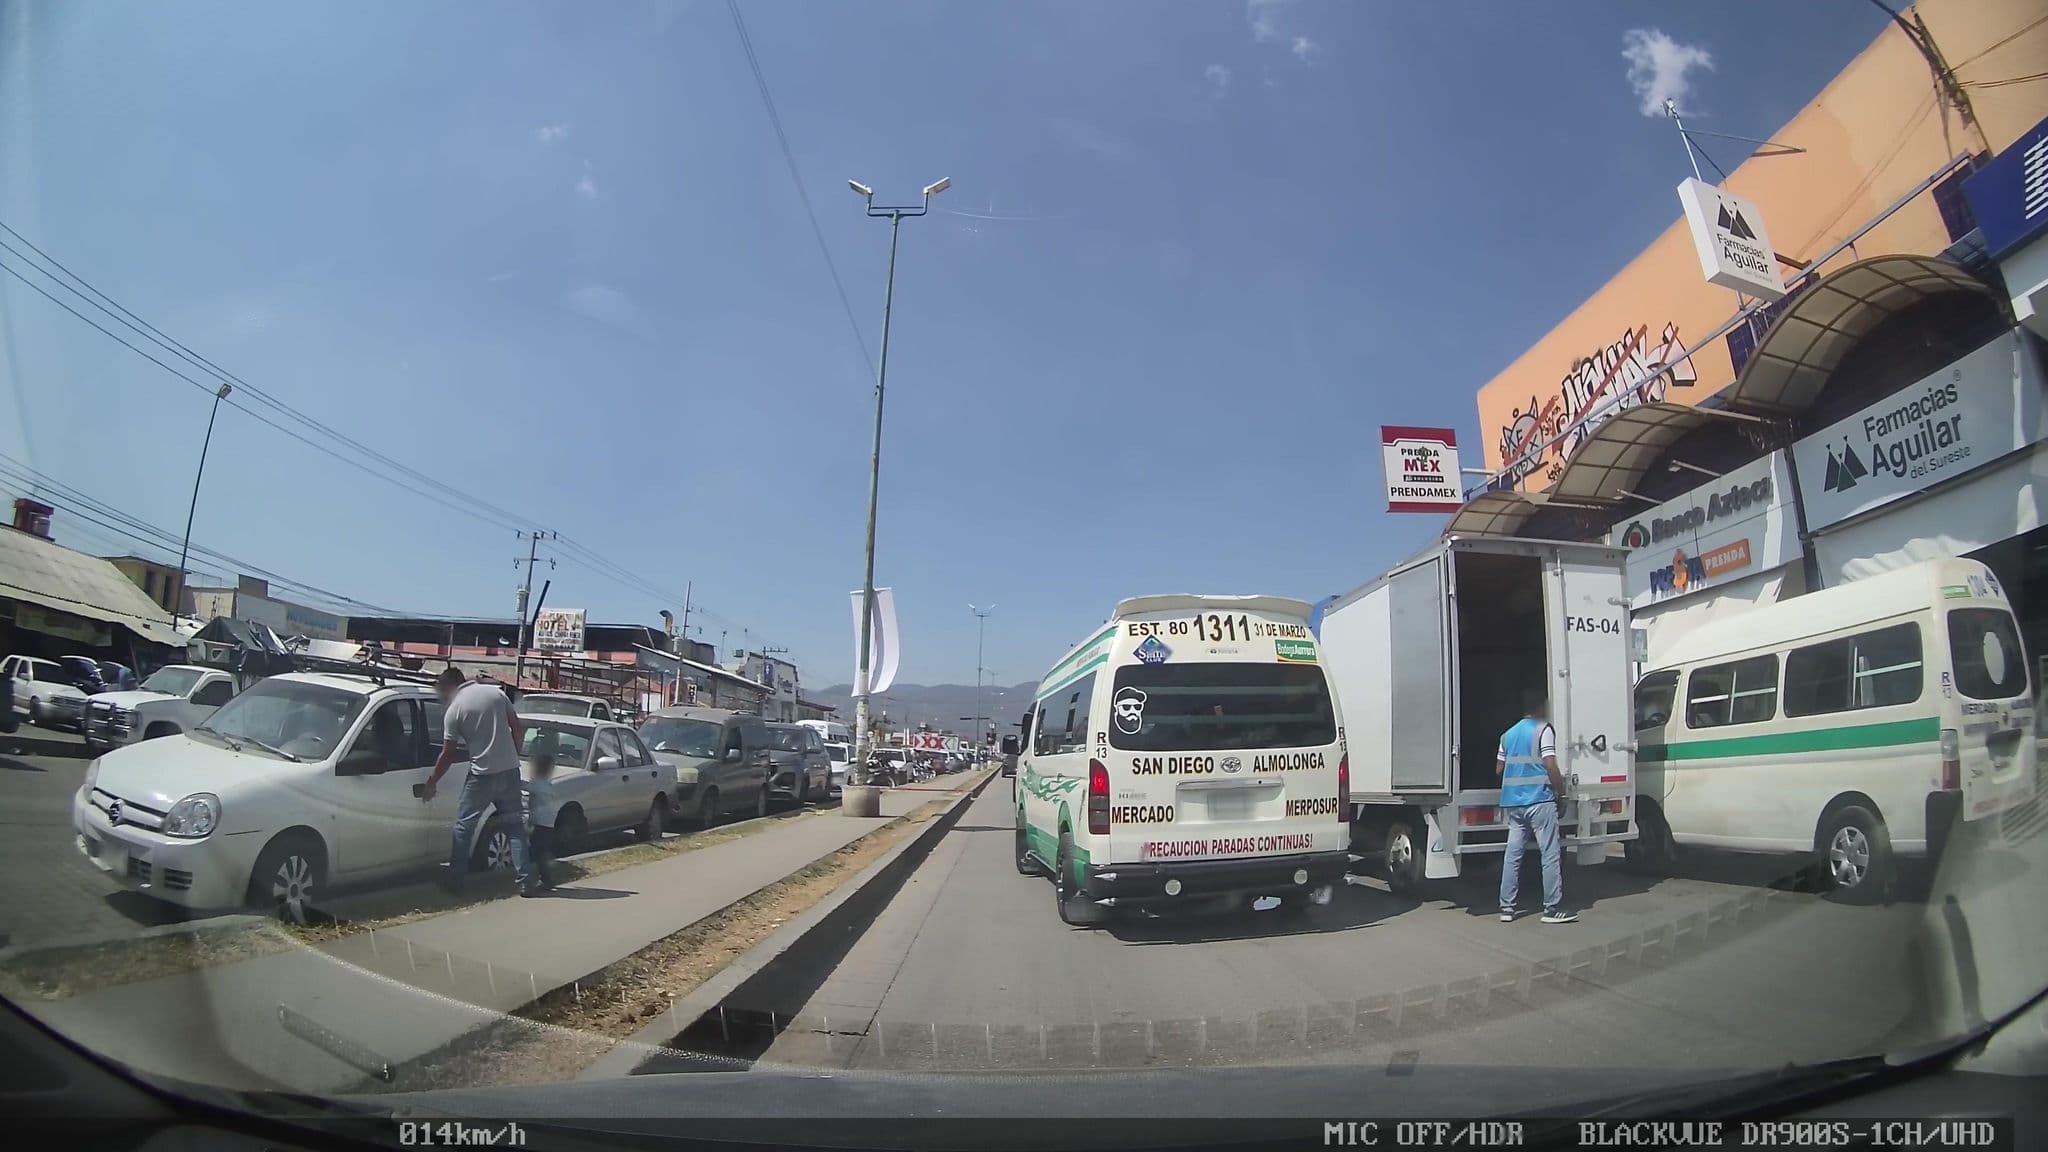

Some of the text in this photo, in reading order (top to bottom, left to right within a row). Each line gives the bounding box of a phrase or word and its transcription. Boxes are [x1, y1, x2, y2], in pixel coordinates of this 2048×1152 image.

[1717, 233, 1764, 259] Farmacias
[1724, 246, 1769, 274] Aguilar
[1863, 383, 1958, 442] Farmacias
[1872, 413, 1962, 478] Aguilar
[1404, 459, 1441, 472] MEX
[1910, 446, 1971, 479] del Sureste
[1390, 487, 1456, 497] PRENDAMEX
[1652, 477, 1773, 543] Banco Azteca
[1705, 547, 1746, 571] PRENDA
[537, 620, 569, 631] HOTEL
[1128, 614, 1306, 641] EST. 80 1311 31 DE MARZO
[1566, 616, 1620, 635] FAS-04
[1941, 672, 1950, 683] R
[1097, 732, 1107, 743] R
[1339, 727, 1346, 739] R
[1096, 747, 1107, 758] 13
[1132, 752, 1325, 775] SAN DIEGO ALMOLONGA
[1111, 805, 1174, 823] MERCADO
[1285, 797, 1338, 816] MERPOSUR
[1143, 833, 1313, 857] RECAUCION PARADAS CONTINUAS!
